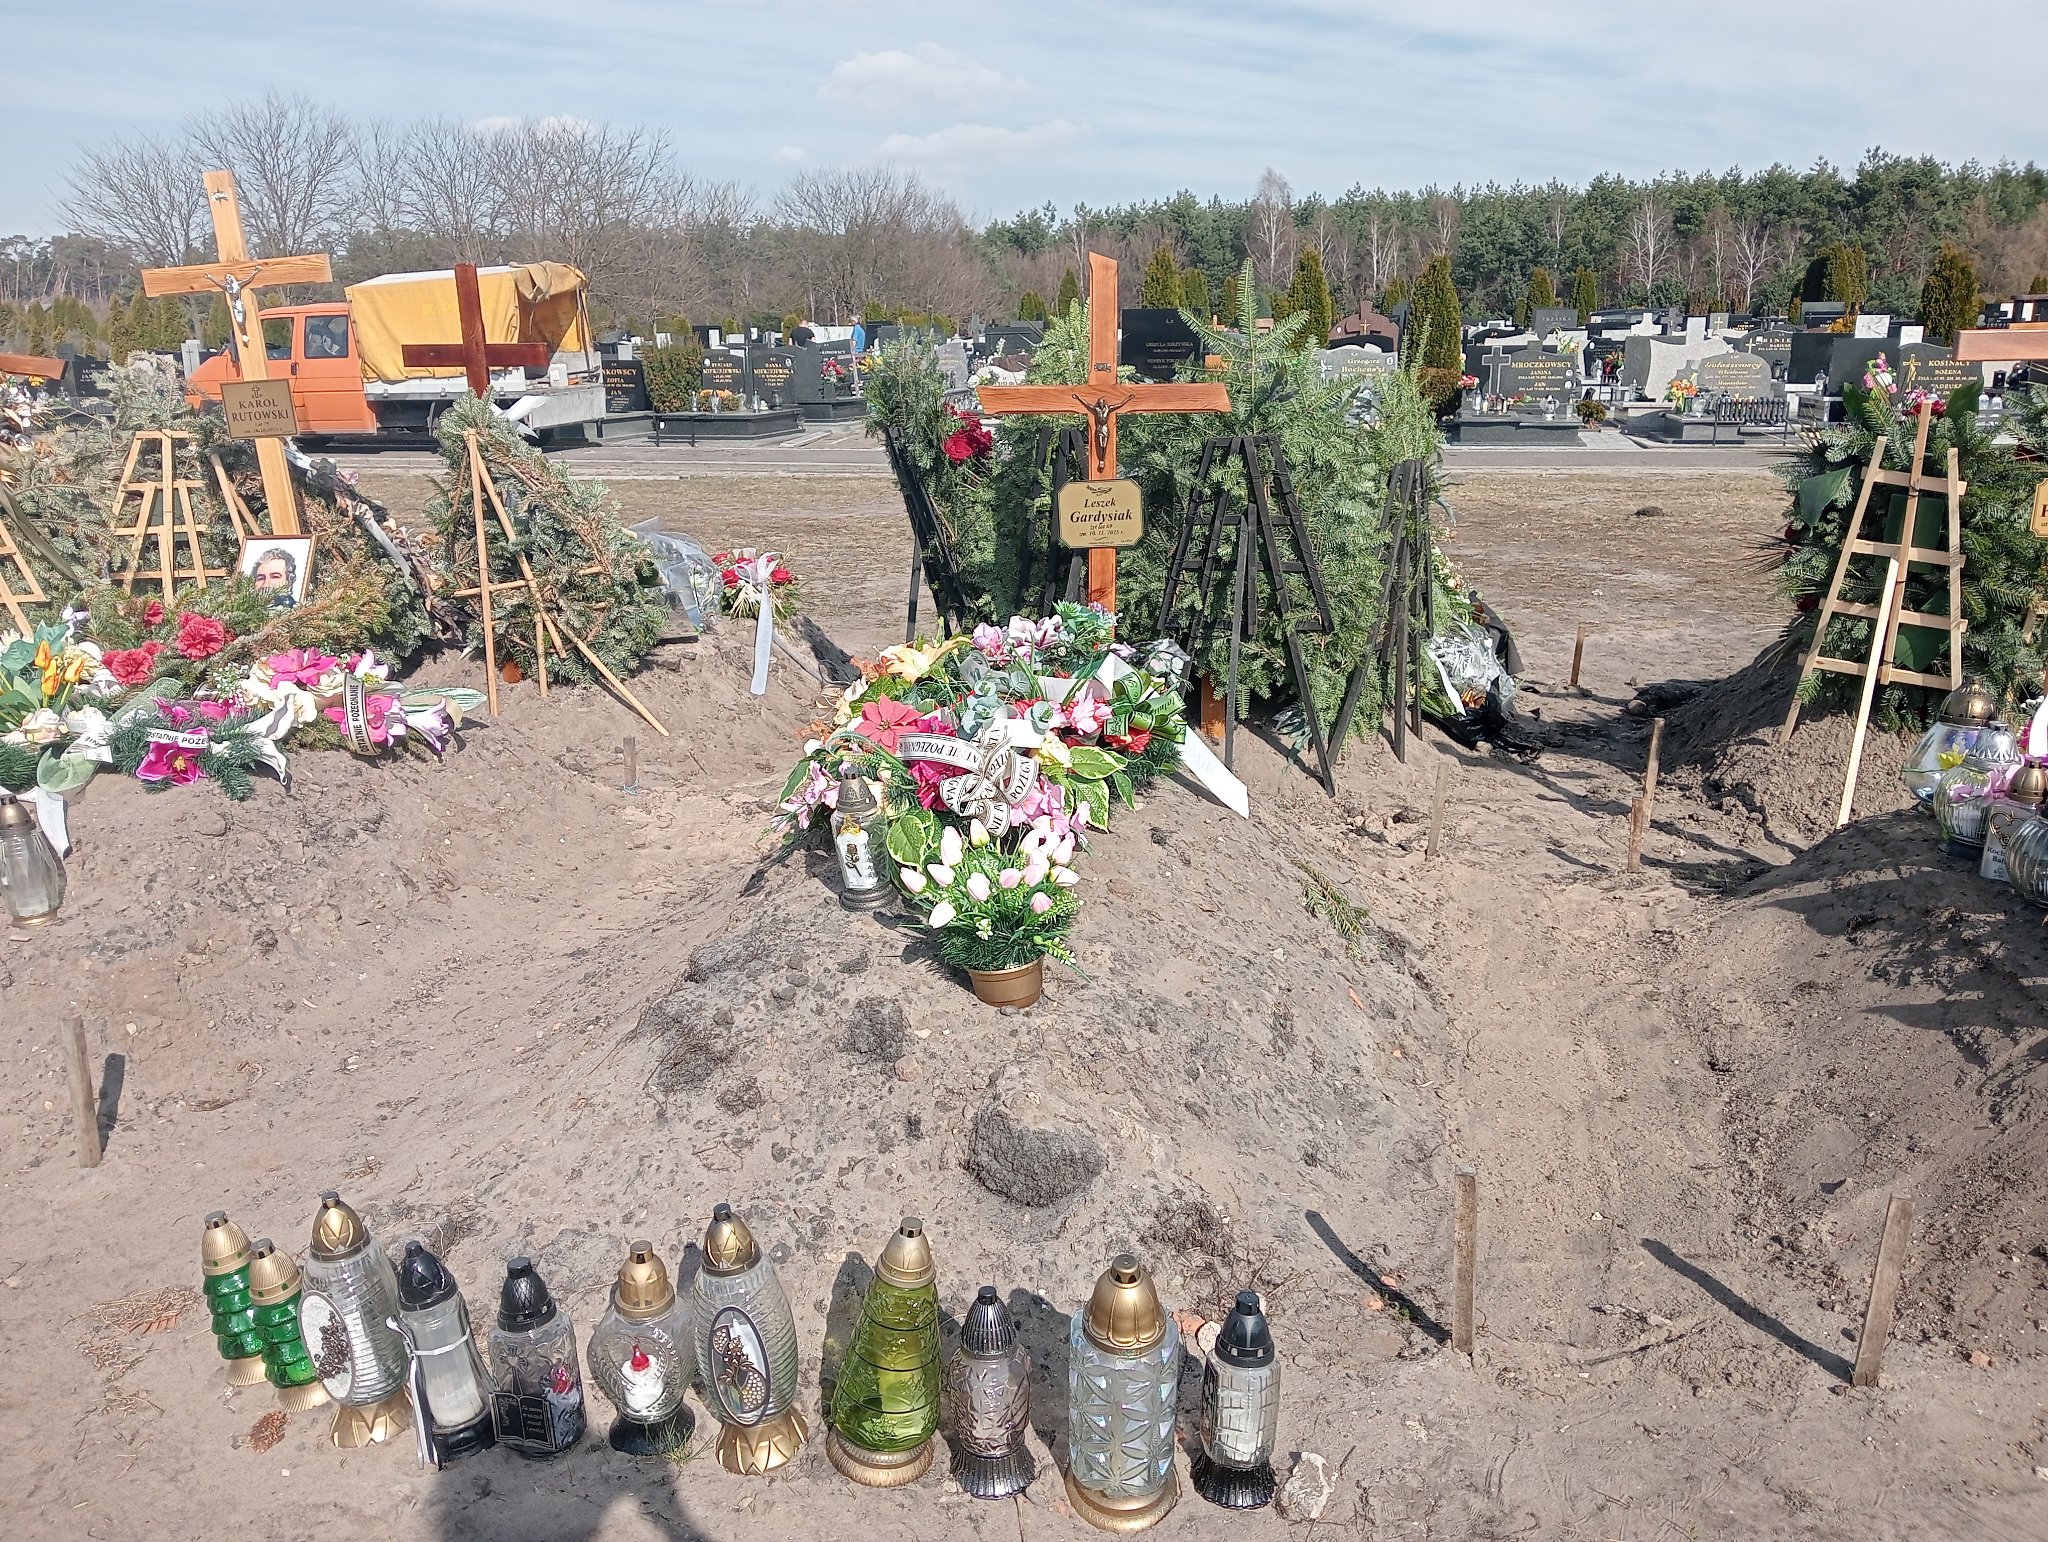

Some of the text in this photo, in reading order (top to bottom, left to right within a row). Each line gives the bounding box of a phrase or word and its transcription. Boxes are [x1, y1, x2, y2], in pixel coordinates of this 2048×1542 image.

[238, 398, 279, 409] KAROL
[231, 409, 289, 422] RUTOWSKI
[1084, 497, 1116, 508] Leszek
[1070, 509, 1133, 525] Gardysiak
[349, 684, 370, 753] OSTATNIE POŻEGNANIE
[145, 731, 179, 742] OSTATNIE
